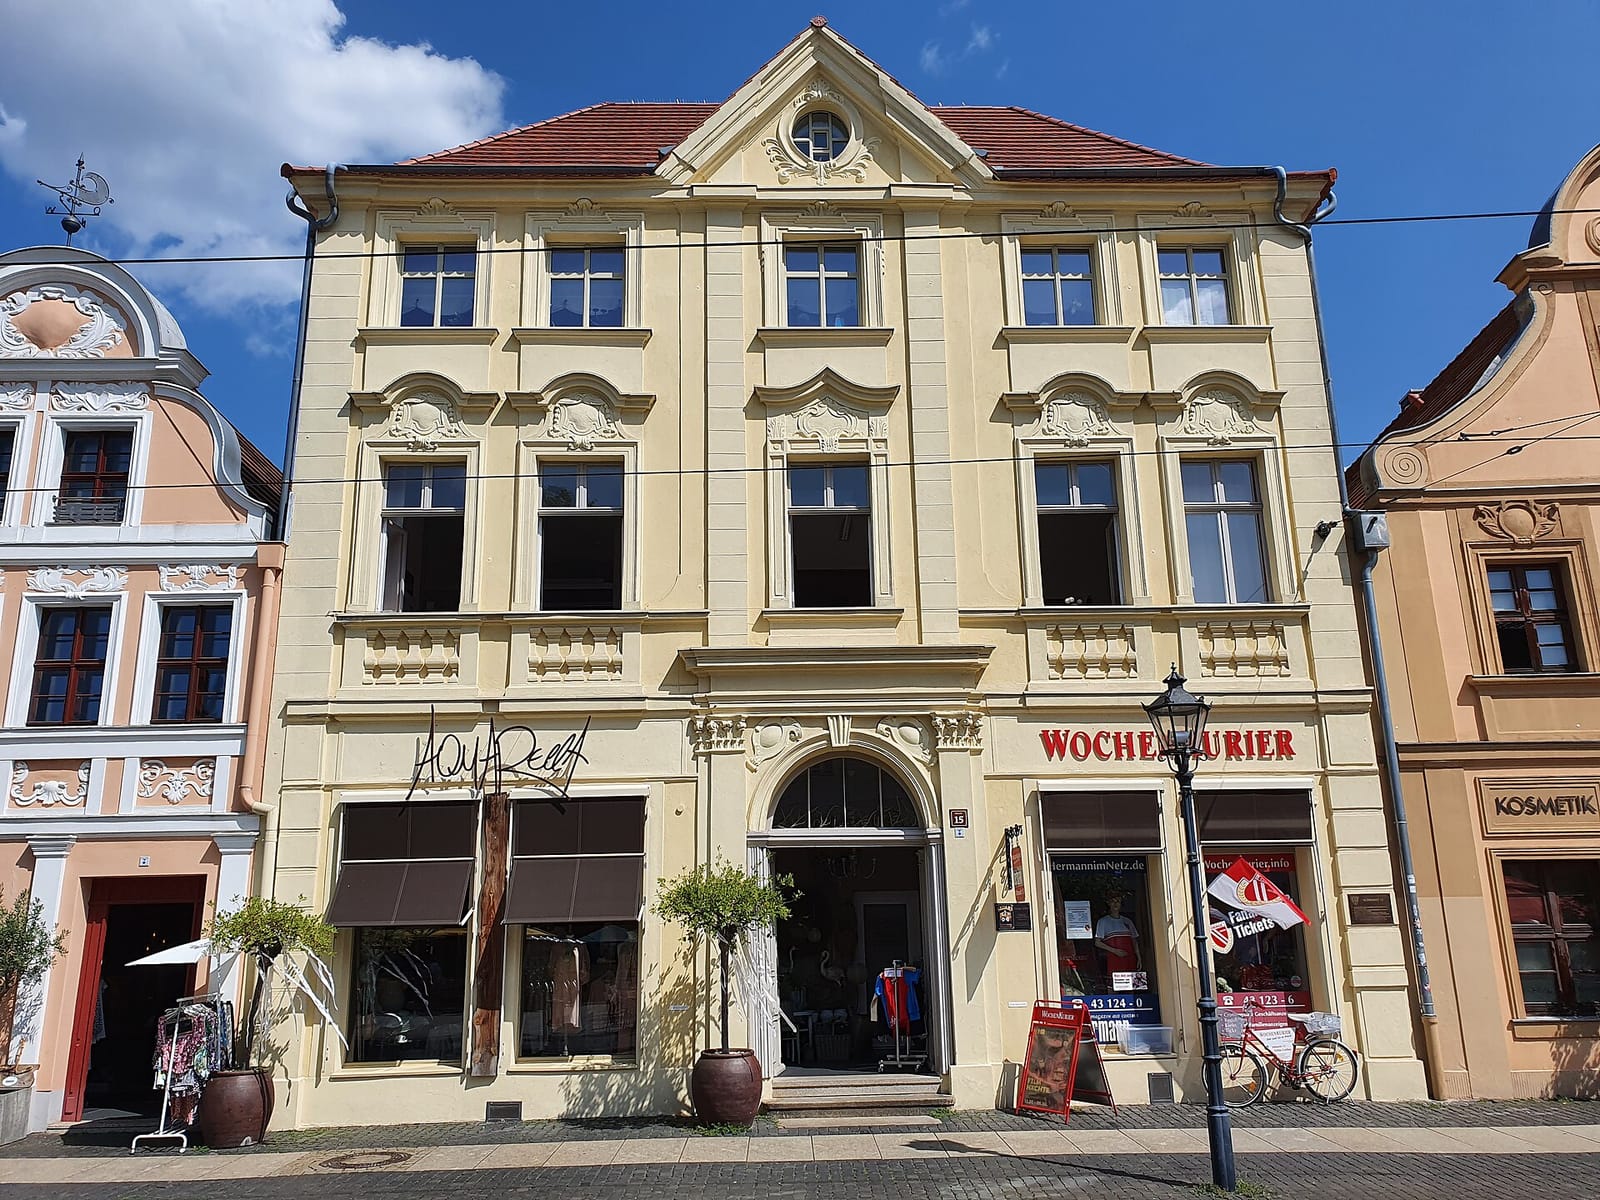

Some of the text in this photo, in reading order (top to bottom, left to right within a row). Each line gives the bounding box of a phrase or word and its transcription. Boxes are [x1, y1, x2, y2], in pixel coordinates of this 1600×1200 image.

[1039, 729, 1297, 761] WOCHEURIER
[1494, 795, 1598, 816] KOSMETIK
[954, 815, 964, 824] 15
[1233, 918, 1275, 939] Tickets
[1091, 999, 1104, 1009] 43
[1107, 999, 1126, 1009] 124
[1136, 998, 1143, 1008] 0
[1259, 996, 1278, 1005] 123
[1288, 995, 1294, 1004] 6
[1092, 1020, 1130, 1043] rmann
